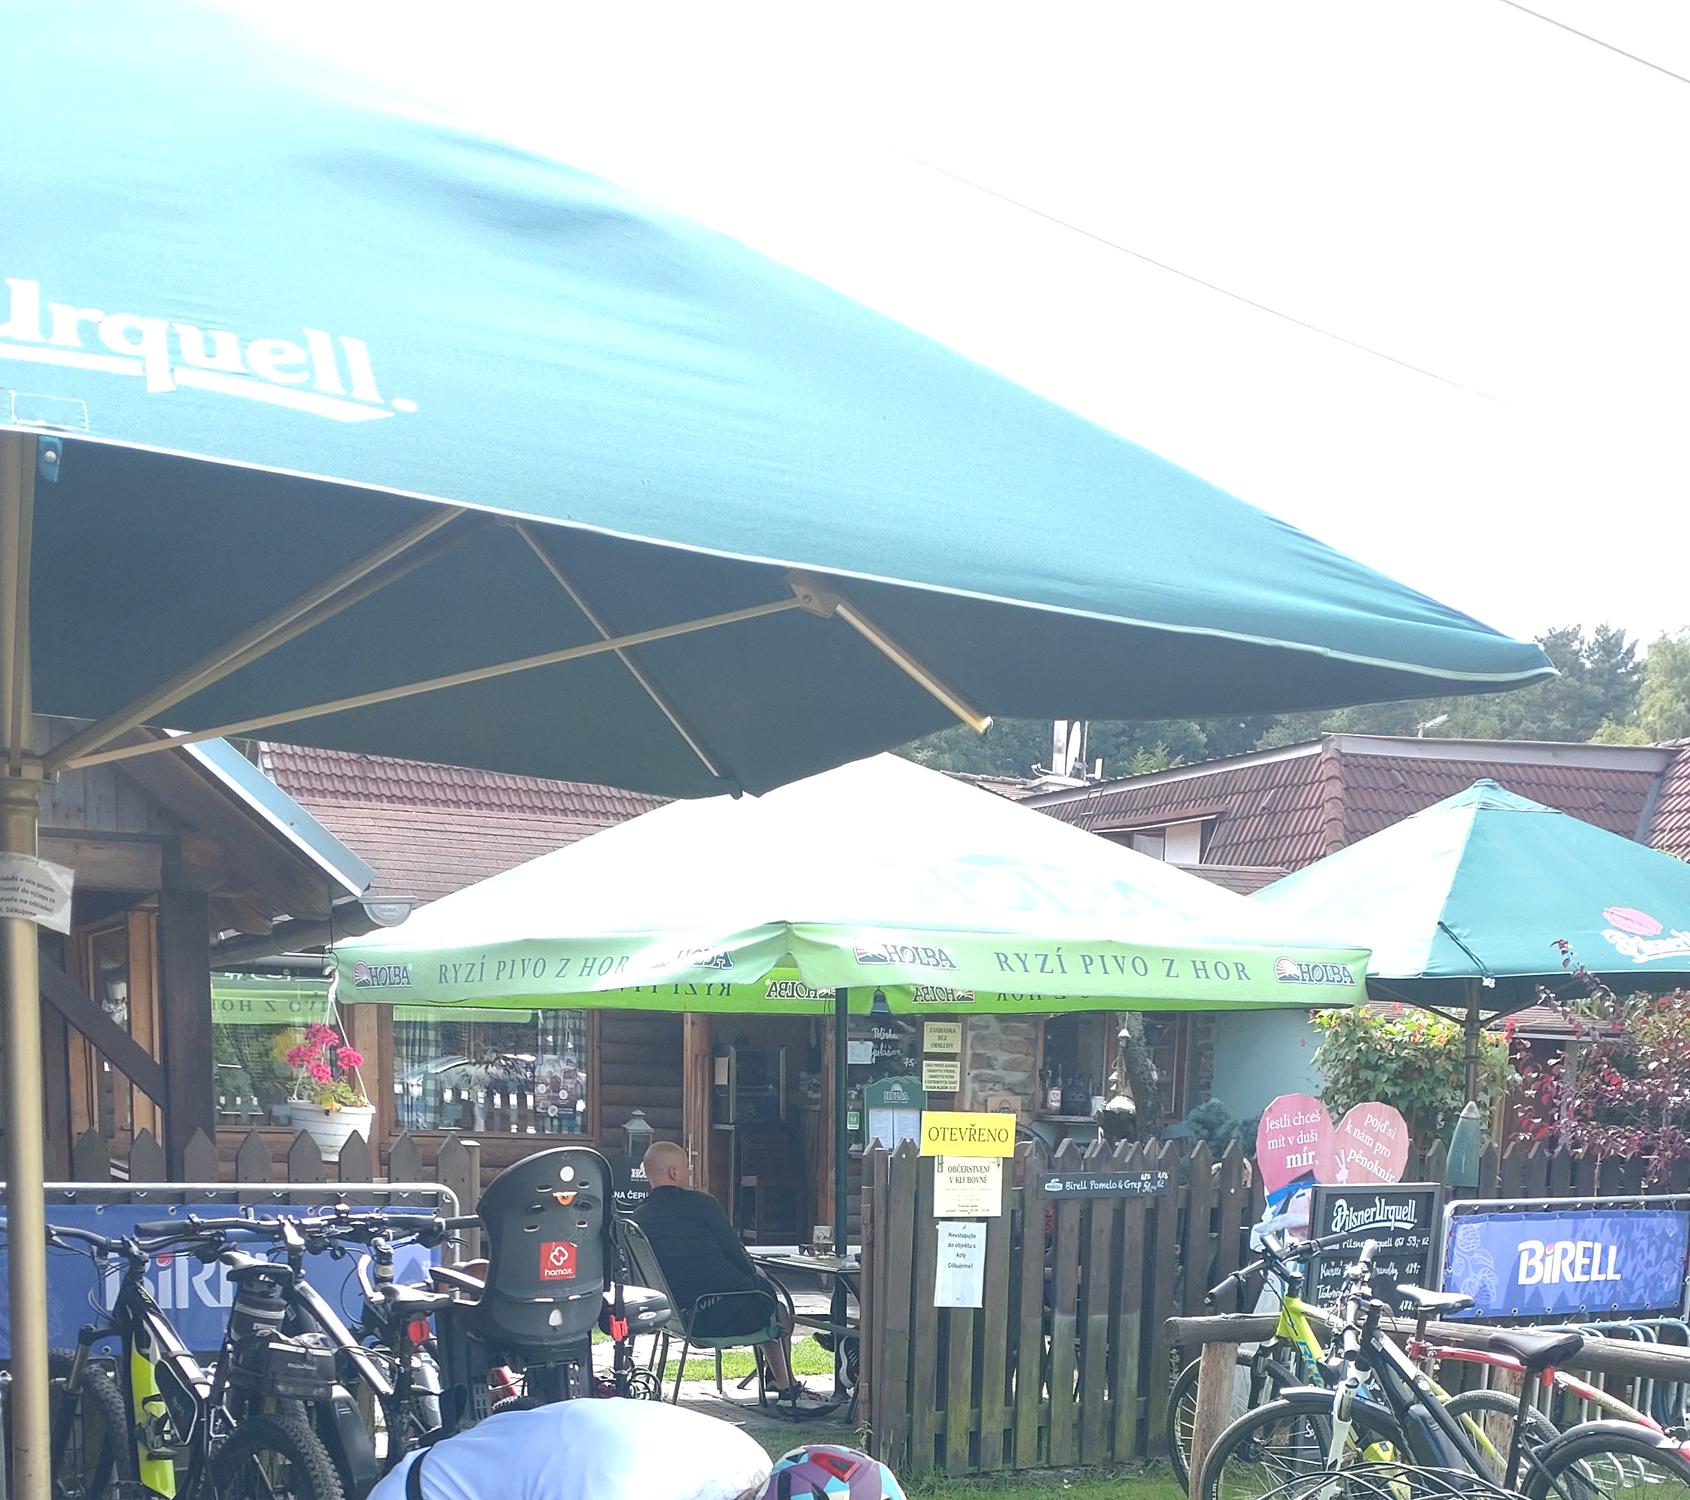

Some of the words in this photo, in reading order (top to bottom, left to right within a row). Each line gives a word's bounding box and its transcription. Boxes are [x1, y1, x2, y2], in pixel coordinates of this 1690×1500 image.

[883, 944, 957, 969] HOLBA
[994, 947, 1068, 974] RYZÍ
[1080, 954, 1149, 977] PIVO
[1162, 958, 1180, 978] Z
[1191, 959, 1252, 982] HOR
[368, 965, 412, 987] HOLBA
[438, 955, 485, 985] RYZÍ
[495, 957, 546, 981] PIVO
[556, 958, 571, 978] Z
[1297, 962, 1356, 985] HOLBA
[1265, 1113, 1291, 1133] Jestli
[1293, 1109, 1321, 1125] chceš
[928, 1123, 1009, 1143] OTEVŘENO
[1267, 1134, 1286, 1150] mít
[1288, 1136, 1295, 1147] v
[1296, 1130, 1319, 1145] duši
[1345, 1119, 1353, 1134] k
[1353, 1127, 1374, 1148] nám
[1372, 1140, 1391, 1158] pro
[1386, 1127, 1397, 1139] si
[614, 1191, 626, 1199] NA
[1065, 1181, 1087, 1190] Birell
[1089, 1180, 1117, 1190] Pomelo
[1331, 1198, 1377, 1232] Pilsner
